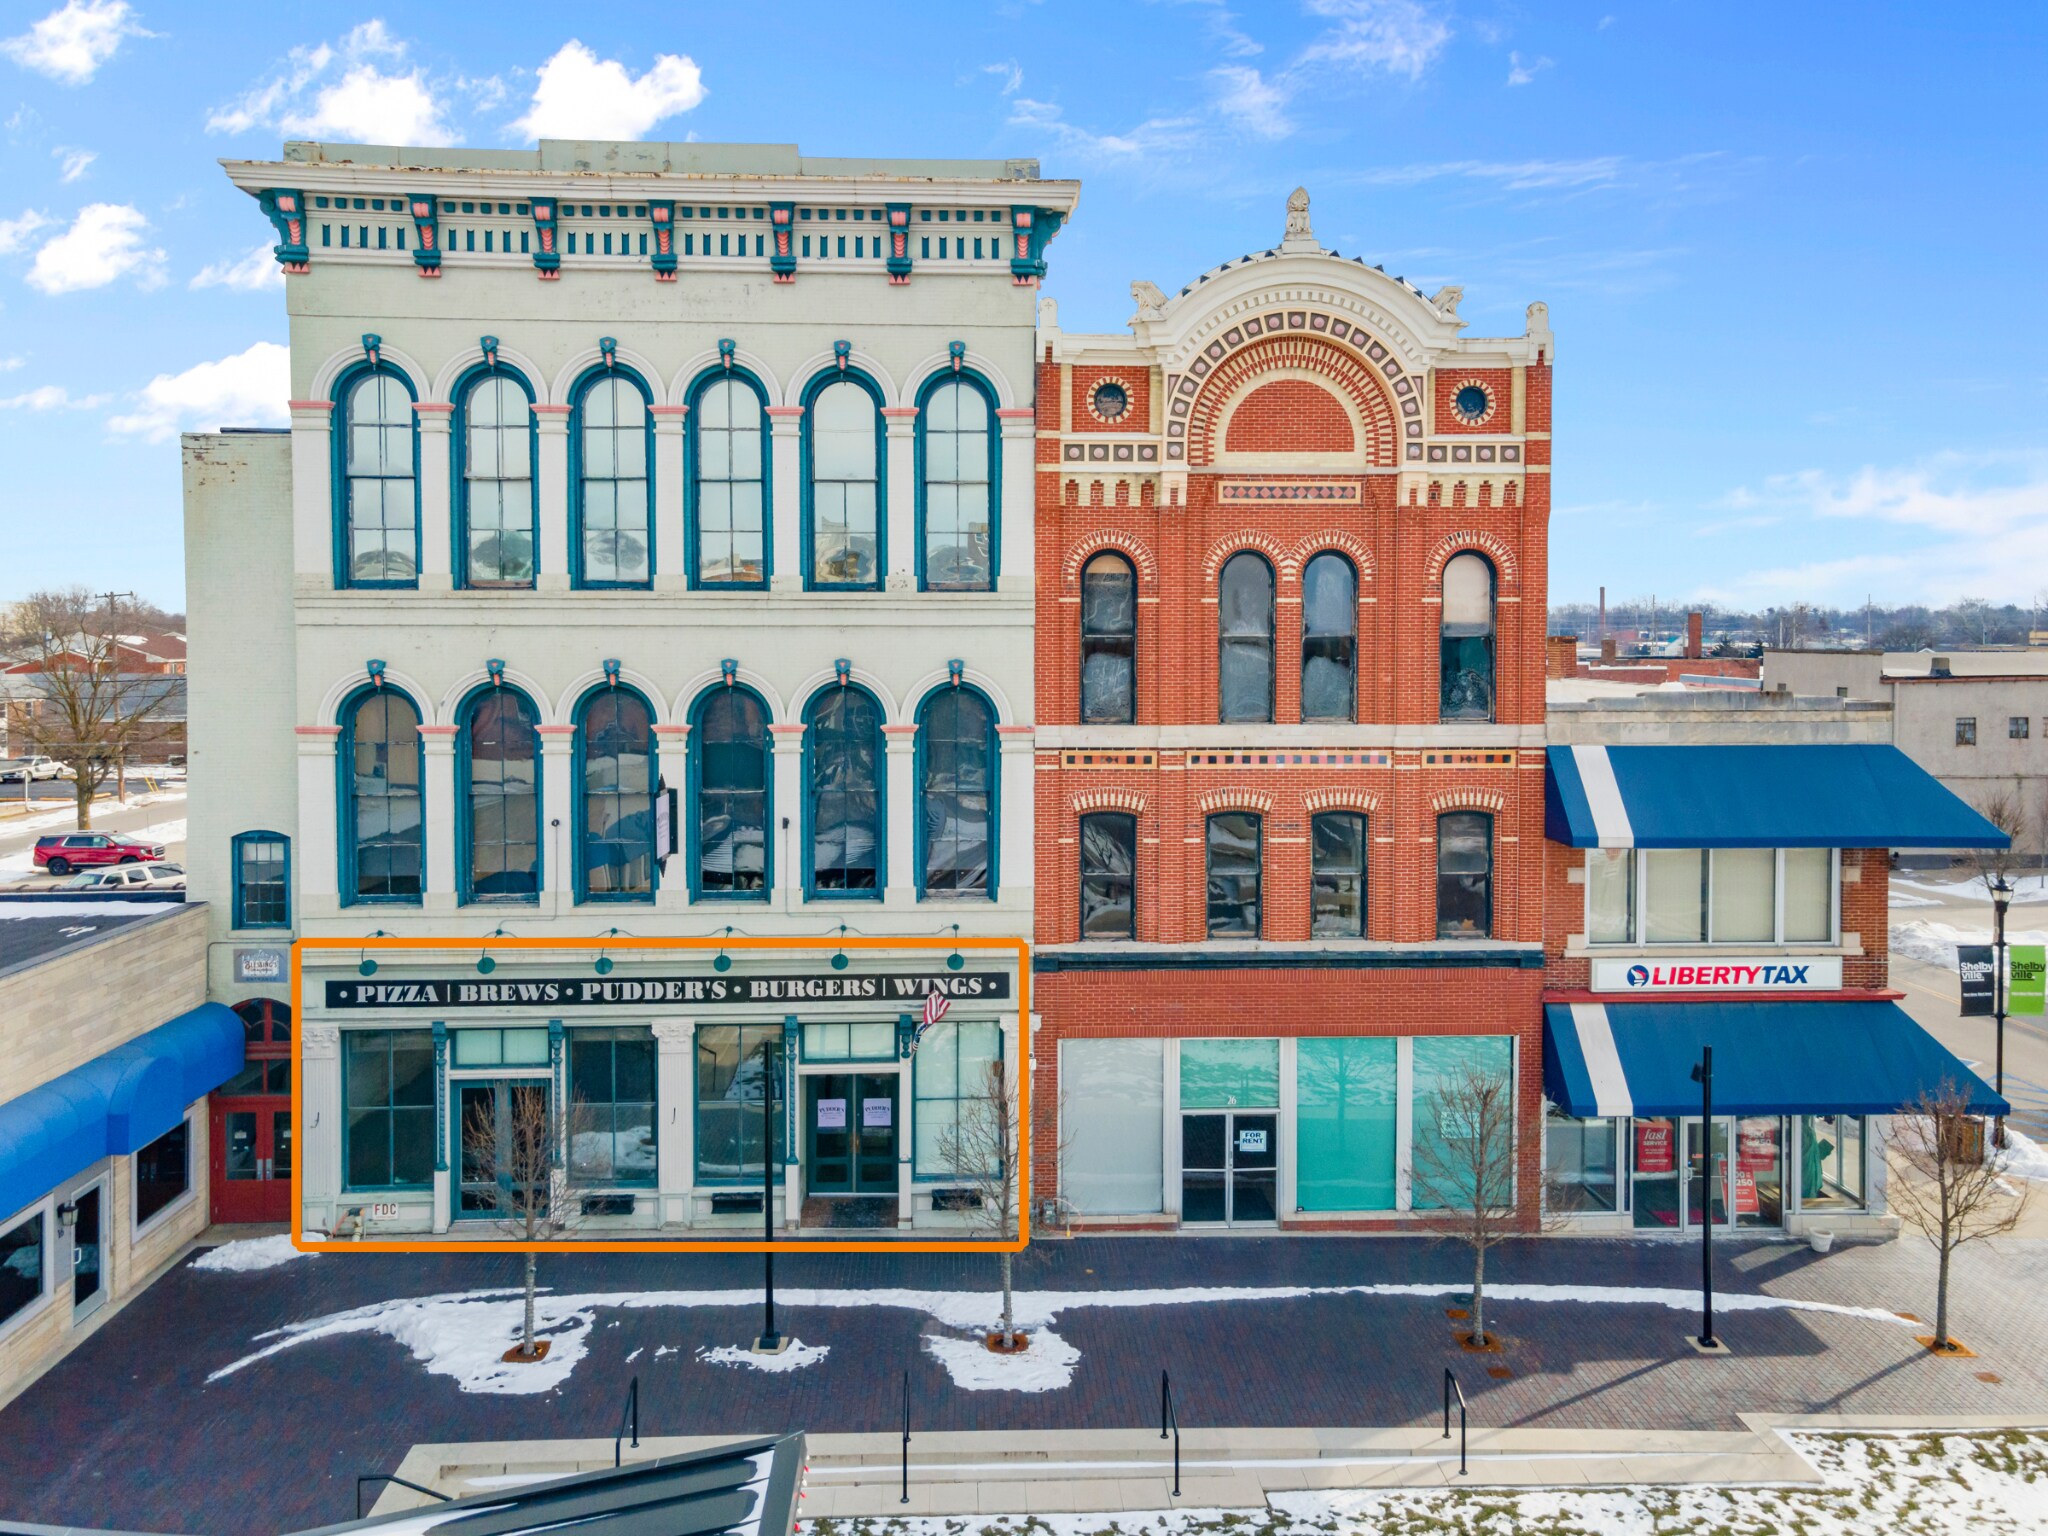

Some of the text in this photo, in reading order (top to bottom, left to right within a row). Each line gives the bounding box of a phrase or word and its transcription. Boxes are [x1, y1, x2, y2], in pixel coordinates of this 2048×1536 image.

[1960, 961, 1993, 972] Shelby
[2011, 961, 2046, 972] Shelby
[355, 977, 982, 1003] PIZZA BREWS PUDDER'S BURGERS WINGS
[1227, 1096, 1237, 1105] 26
[374, 1203, 397, 1215] FDC
